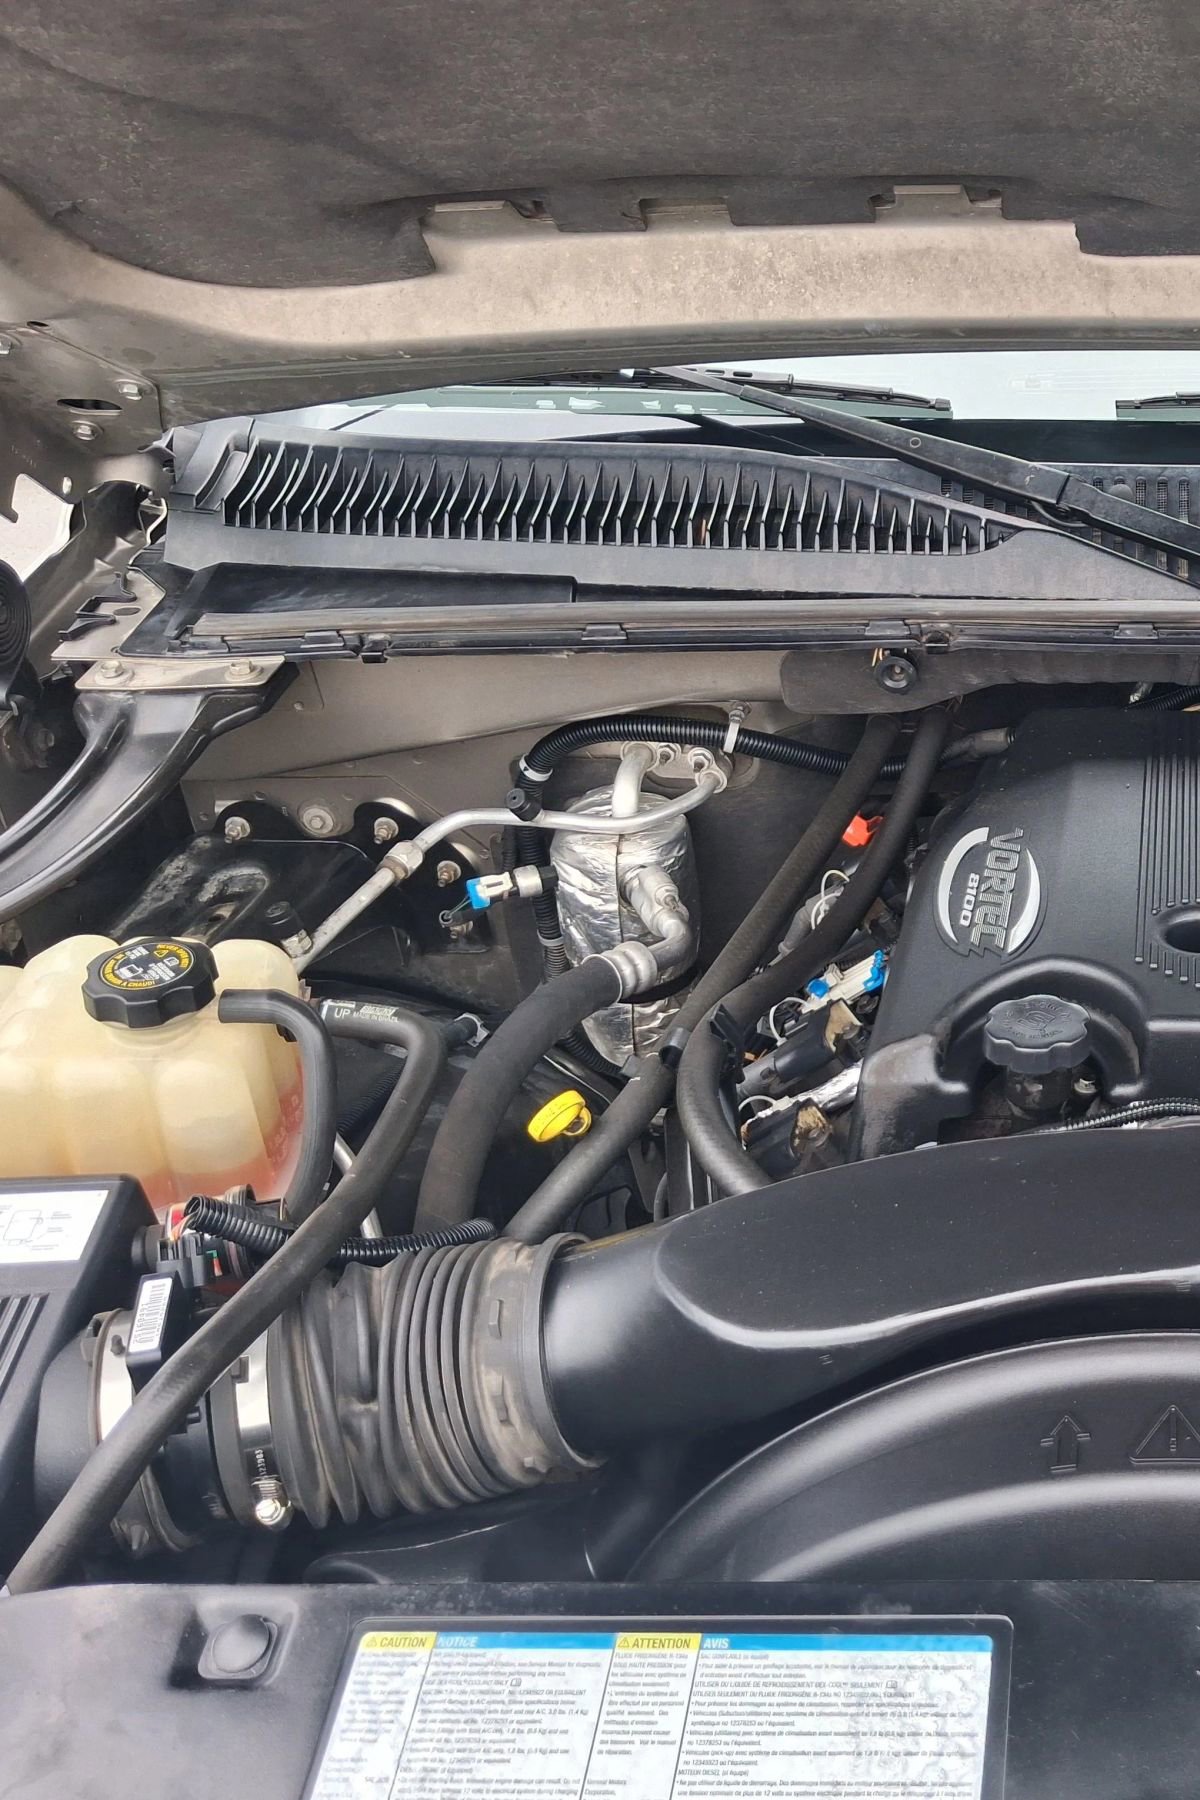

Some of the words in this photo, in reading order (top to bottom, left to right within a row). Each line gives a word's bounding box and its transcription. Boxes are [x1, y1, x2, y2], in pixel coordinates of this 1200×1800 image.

[971, 827, 1024, 948] VORTEC
[960, 873, 980, 927] 8100
[334, 1007, 351, 1019] UP
[380, 1637, 427, 1647] CAUTION
[438, 1637, 478, 1647] NOTICE
[632, 1638, 691, 1648] ATTENTION
[703, 1638, 730, 1648] AVIS
